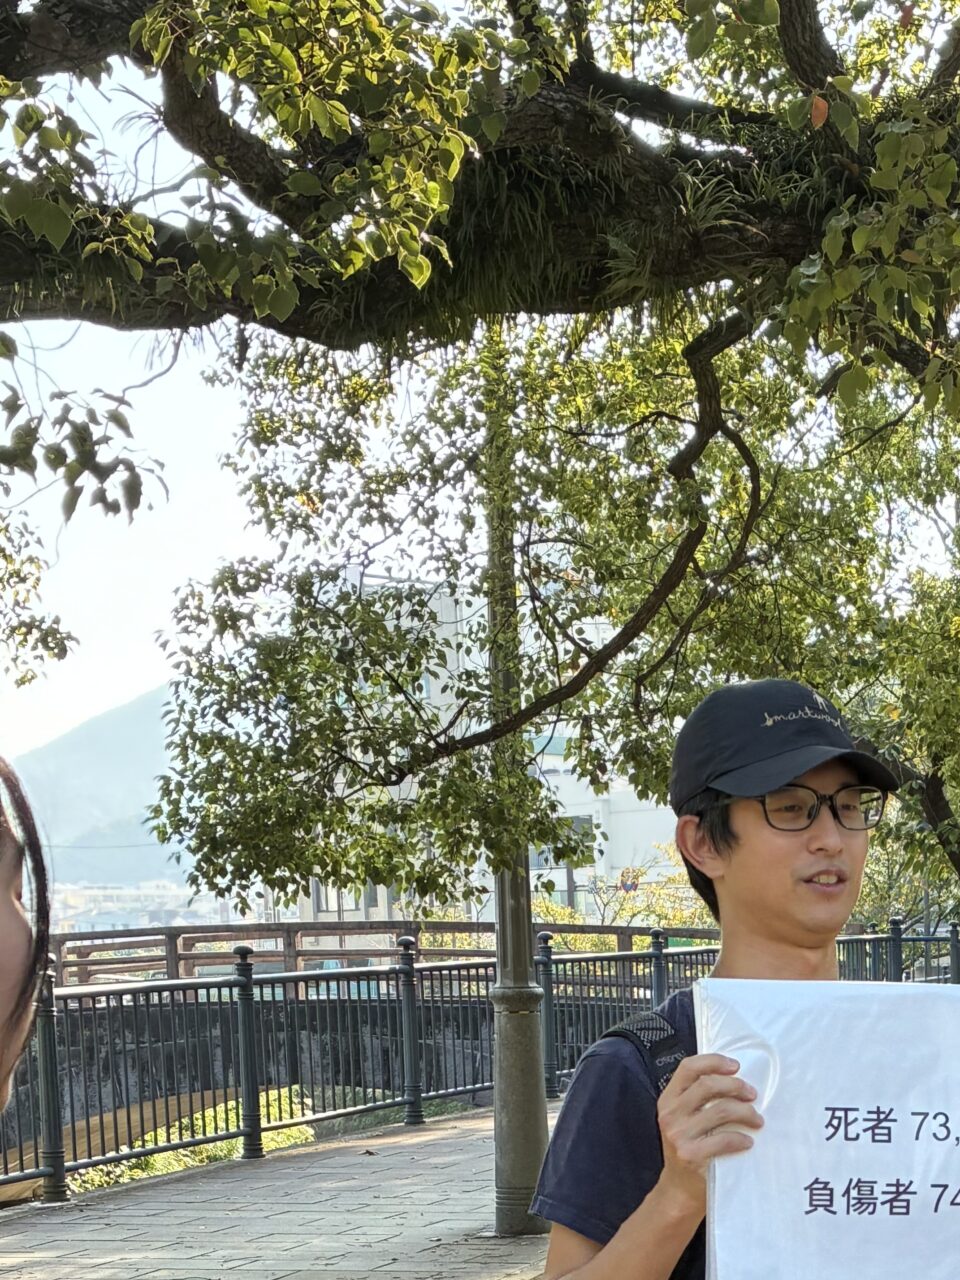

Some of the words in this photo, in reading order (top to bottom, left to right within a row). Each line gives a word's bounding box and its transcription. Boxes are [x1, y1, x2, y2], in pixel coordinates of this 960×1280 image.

[824, 1105, 898, 1144] 死者
[803, 1177, 918, 1216] 負傷者
